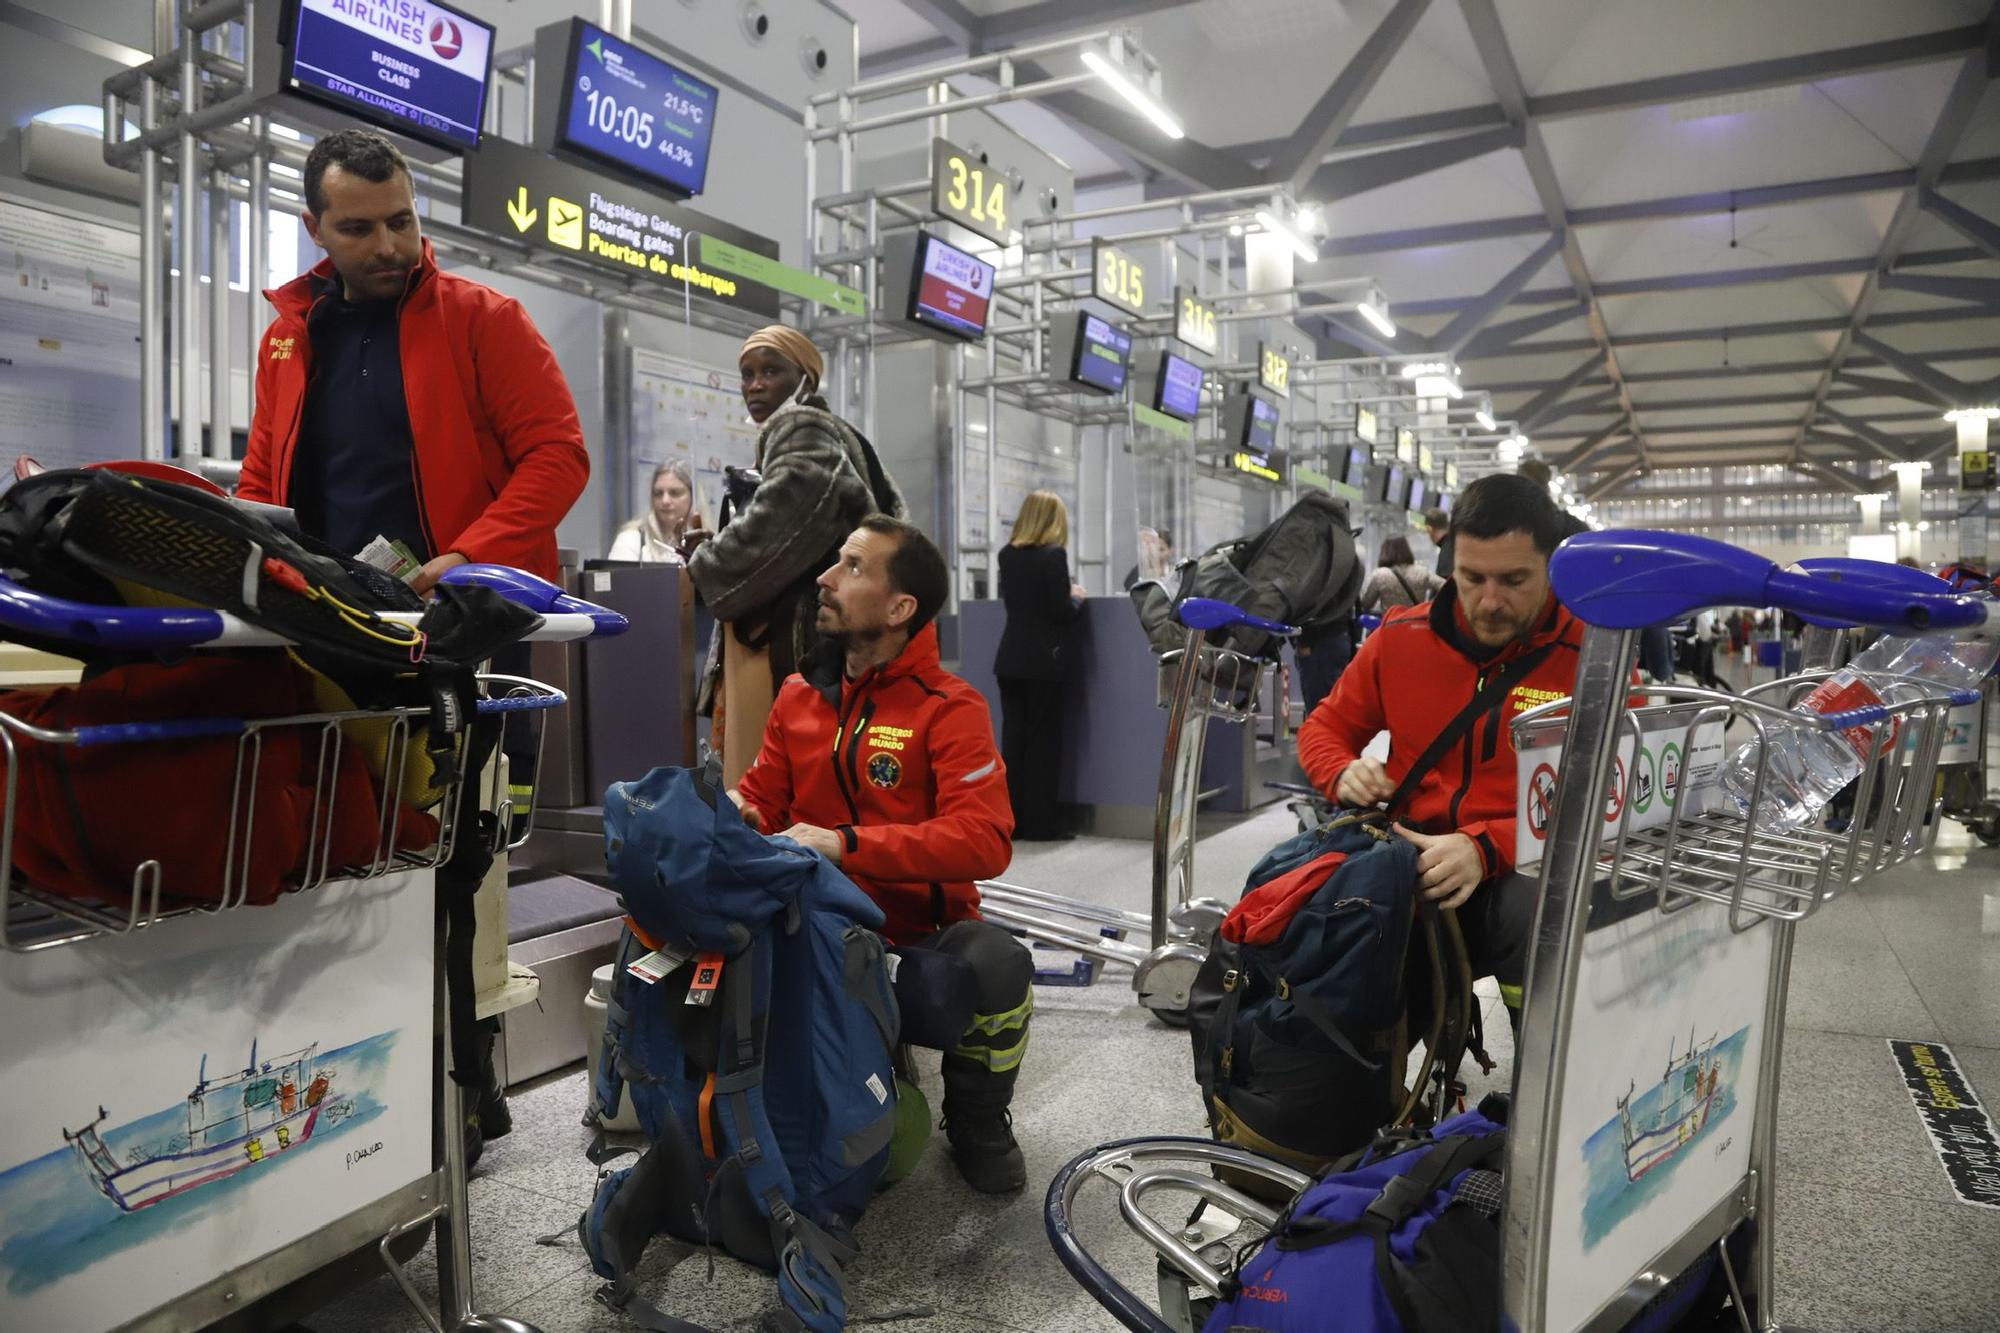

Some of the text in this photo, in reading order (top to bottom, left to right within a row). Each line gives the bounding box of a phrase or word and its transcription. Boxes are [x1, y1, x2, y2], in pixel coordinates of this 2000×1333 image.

[332, 0, 424, 45] AIRLINES
[366, 0, 425, 26] KISH
[371, 50, 421, 79] BUSINESS
[377, 68, 411, 90] CLASS
[326, 78, 450, 132] STAR ALLIANCE GOLD
[586, 89, 655, 149] 10:05
[590, 192, 682, 240] Flugsteige Gates
[947, 156, 1007, 232] 314
[589, 212, 675, 256] Boarding gates
[588, 232, 647, 269] Puertas
[650, 253, 669, 275] de
[671, 262, 737, 297] embarque
[1102, 250, 1144, 308] 315
[1182, 297, 1217, 341] 316
[868, 725, 914, 738] BOMBEROS
[868, 737, 905, 751] MUNDO
